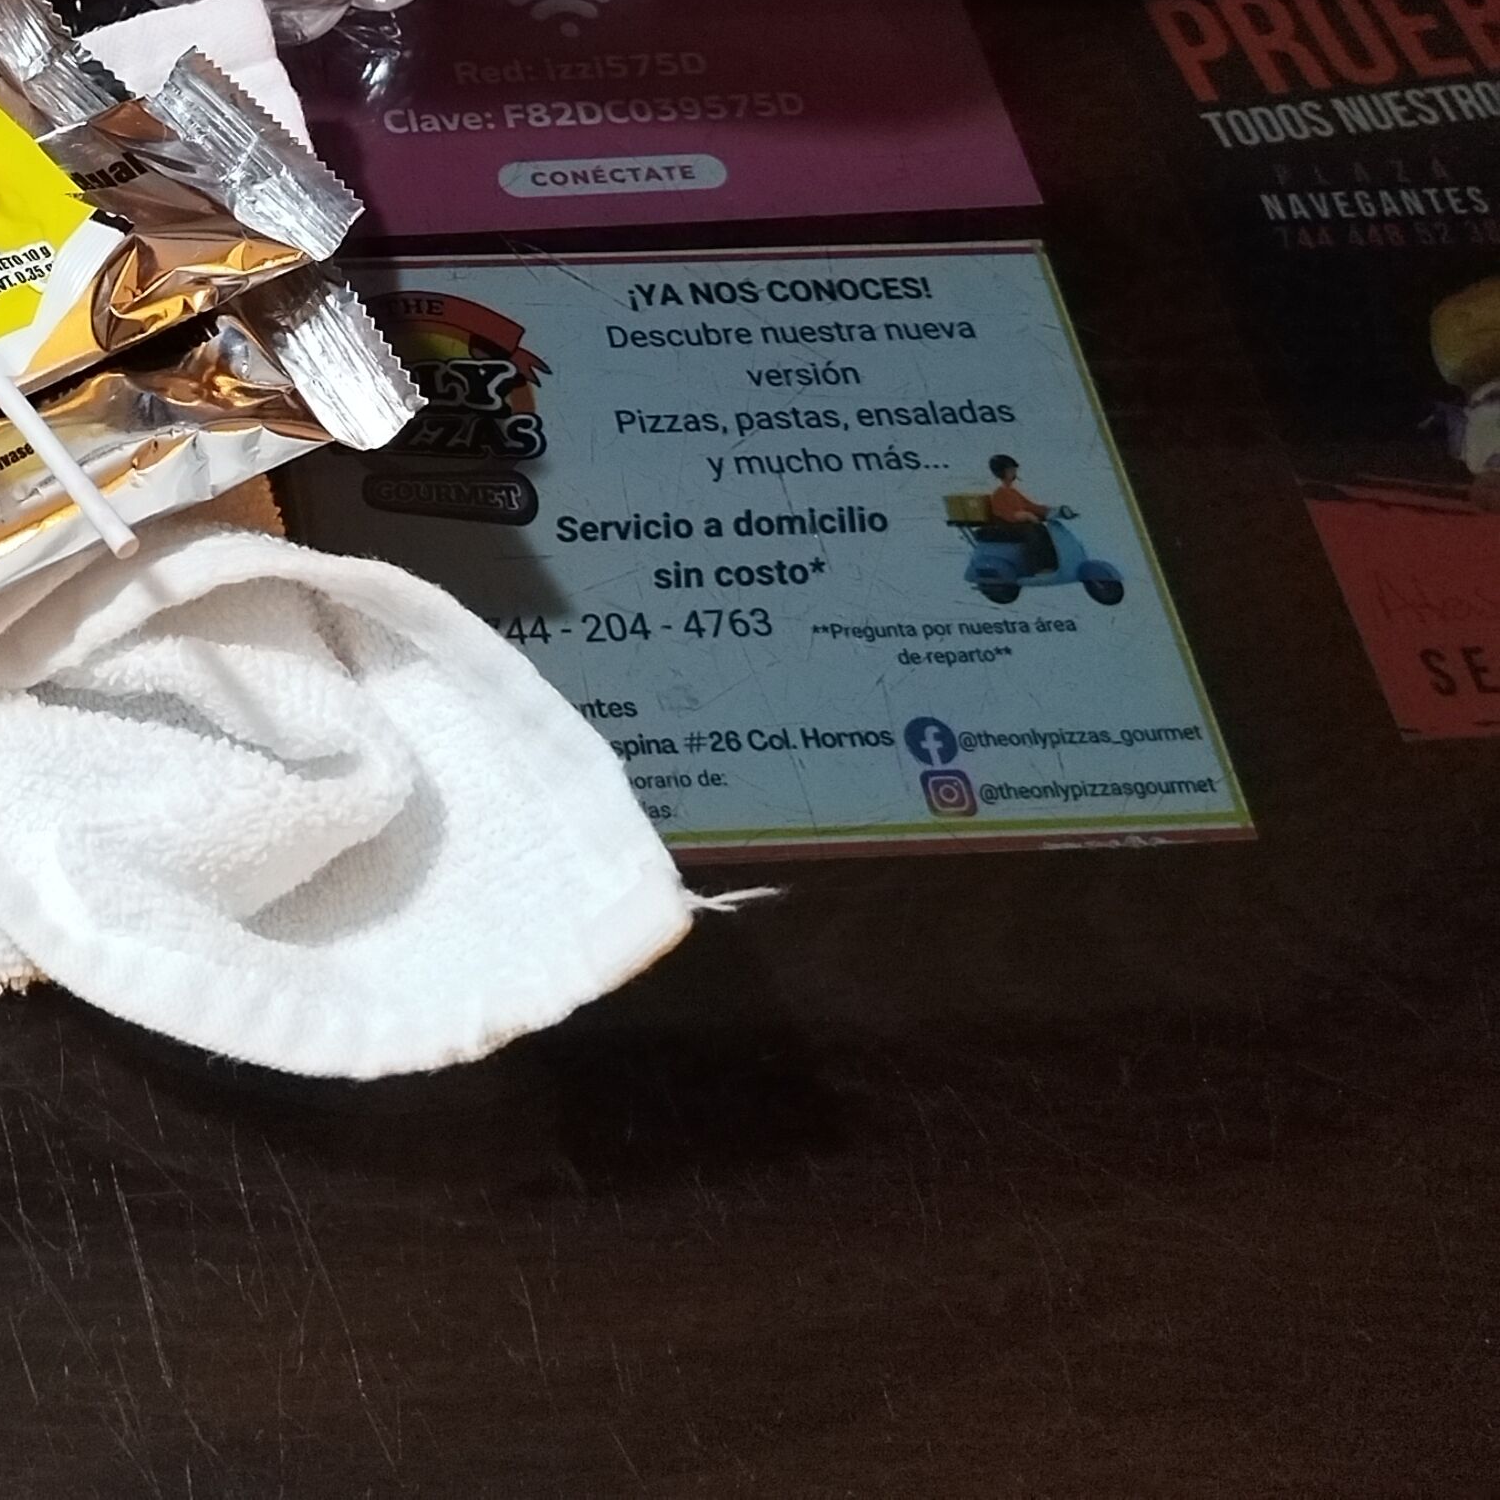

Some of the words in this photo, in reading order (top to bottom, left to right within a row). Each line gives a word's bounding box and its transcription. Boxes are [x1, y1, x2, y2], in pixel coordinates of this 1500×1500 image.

[454, 57, 534, 87] Red:
[543, 50, 709, 83] izzi575D
[383, 105, 495, 136] Clave:
[503, 92, 806, 132] F82DC039575D
[1200, 103, 1335, 149] TODOS
[530, 161, 696, 188] CONÉCTATE
[1259, 185, 1491, 223] NAVEGANTES
[14, 263, 46, 284] 0.35
[21, 248, 41, 263] 10
[627, 283, 684, 312] ¡YA
[689, 281, 760, 306] NOS
[765, 276, 932, 303] CONOCES!
[606, 321, 753, 349] Descubre
[761, 318, 877, 345] nuestra
[884, 317, 976, 342] nueva
[747, 360, 861, 388] versión
[614, 409, 729, 436] Pizzas,
[735, 406, 850, 437] pastas,
[856, 399, 1016, 428] ensaladas
[706, 455, 724, 482] y
[734, 447, 843, 476] mucho
[851, 443, 950, 473] más...
[556, 513, 694, 543] Servicio
[703, 518, 724, 538] a
[733, 505, 889, 538] domicilio
[653, 561, 704, 589] sin
[580, 611, 652, 644] 204
[683, 607, 774, 640] 4763
[923, 621, 954, 640] por
[958, 617, 1031, 636] nuestra
[1035, 615, 1078, 634] área
[898, 648, 922, 667] de
[683, 730, 742, 754] #26
[747, 727, 798, 752] Col.
[800, 726, 896, 749] Hornos
[958, 724, 1204, 753] @theonlypizzas_gourmet
[698, 769, 729, 788] de:
[979, 775, 1217, 806] @theonlypizzasgourmet
